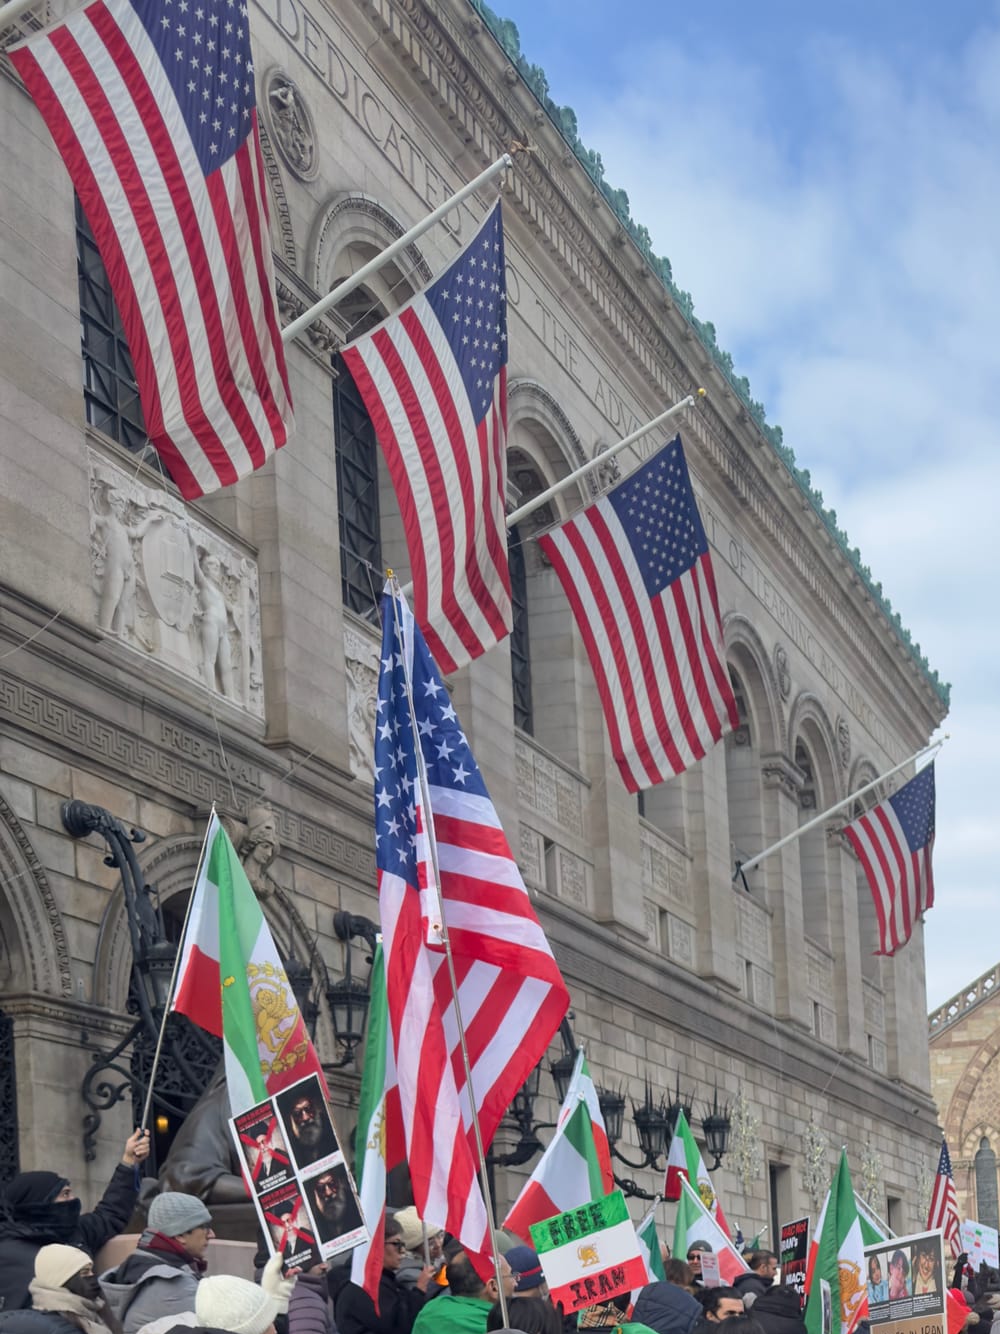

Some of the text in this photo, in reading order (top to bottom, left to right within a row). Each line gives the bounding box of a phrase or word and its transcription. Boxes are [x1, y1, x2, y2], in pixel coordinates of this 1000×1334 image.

[536, 299, 581, 383] THE
[728, 539, 747, 577] OF
[547, 1202, 607, 1246] FREE
[570, 1266, 626, 1308] IRAN
